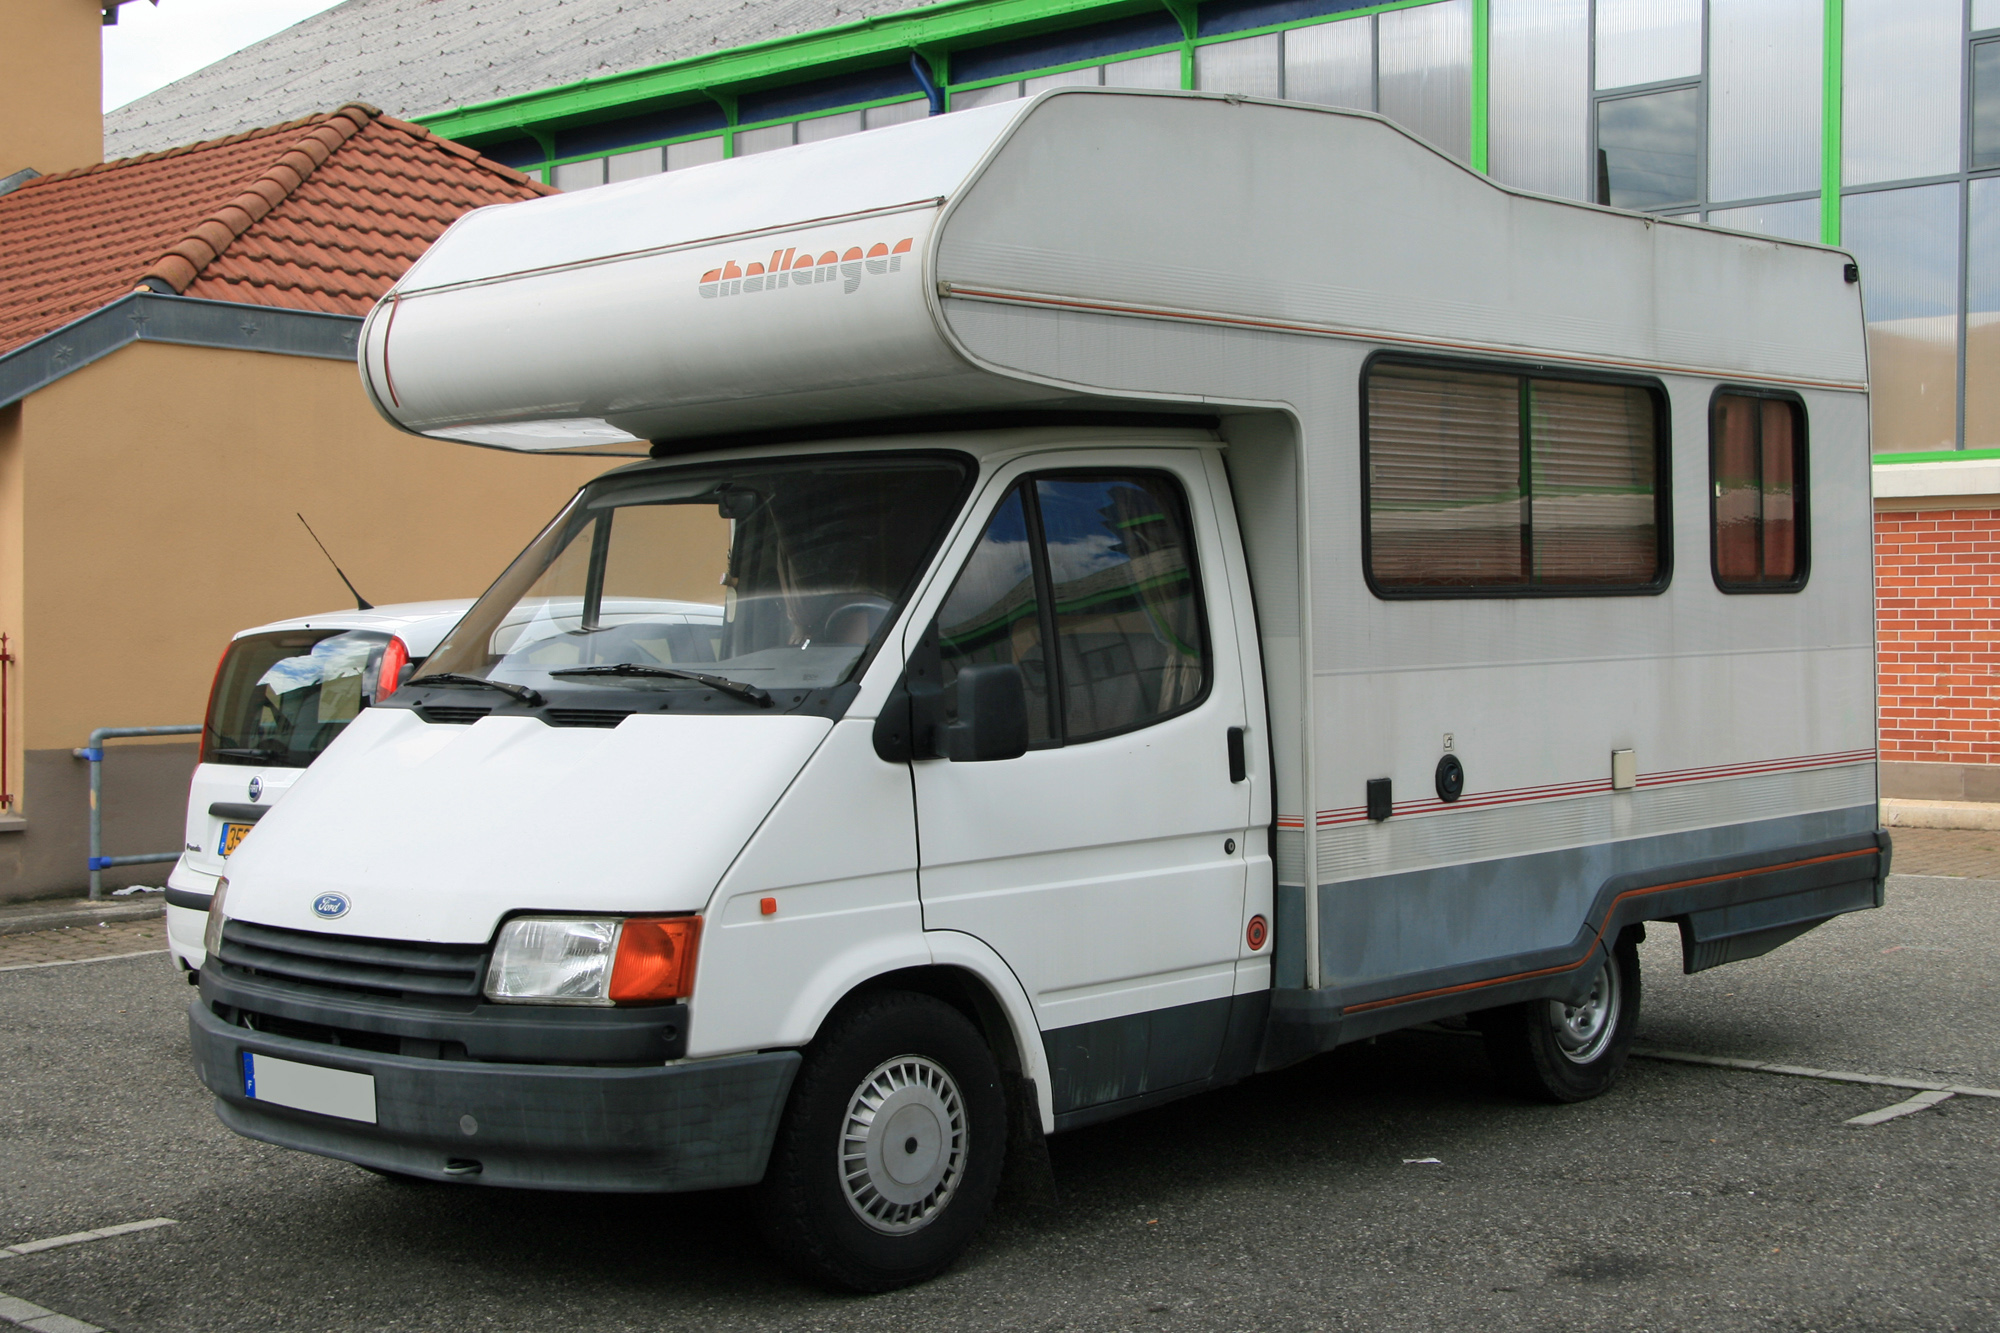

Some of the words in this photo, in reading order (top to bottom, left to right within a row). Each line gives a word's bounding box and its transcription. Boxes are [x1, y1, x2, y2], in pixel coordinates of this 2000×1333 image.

[698, 237, 914, 299] challenger
[227, 827, 250, 851] 35
[318, 896, 341, 913] Ford
[247, 1079, 252, 1089] F
